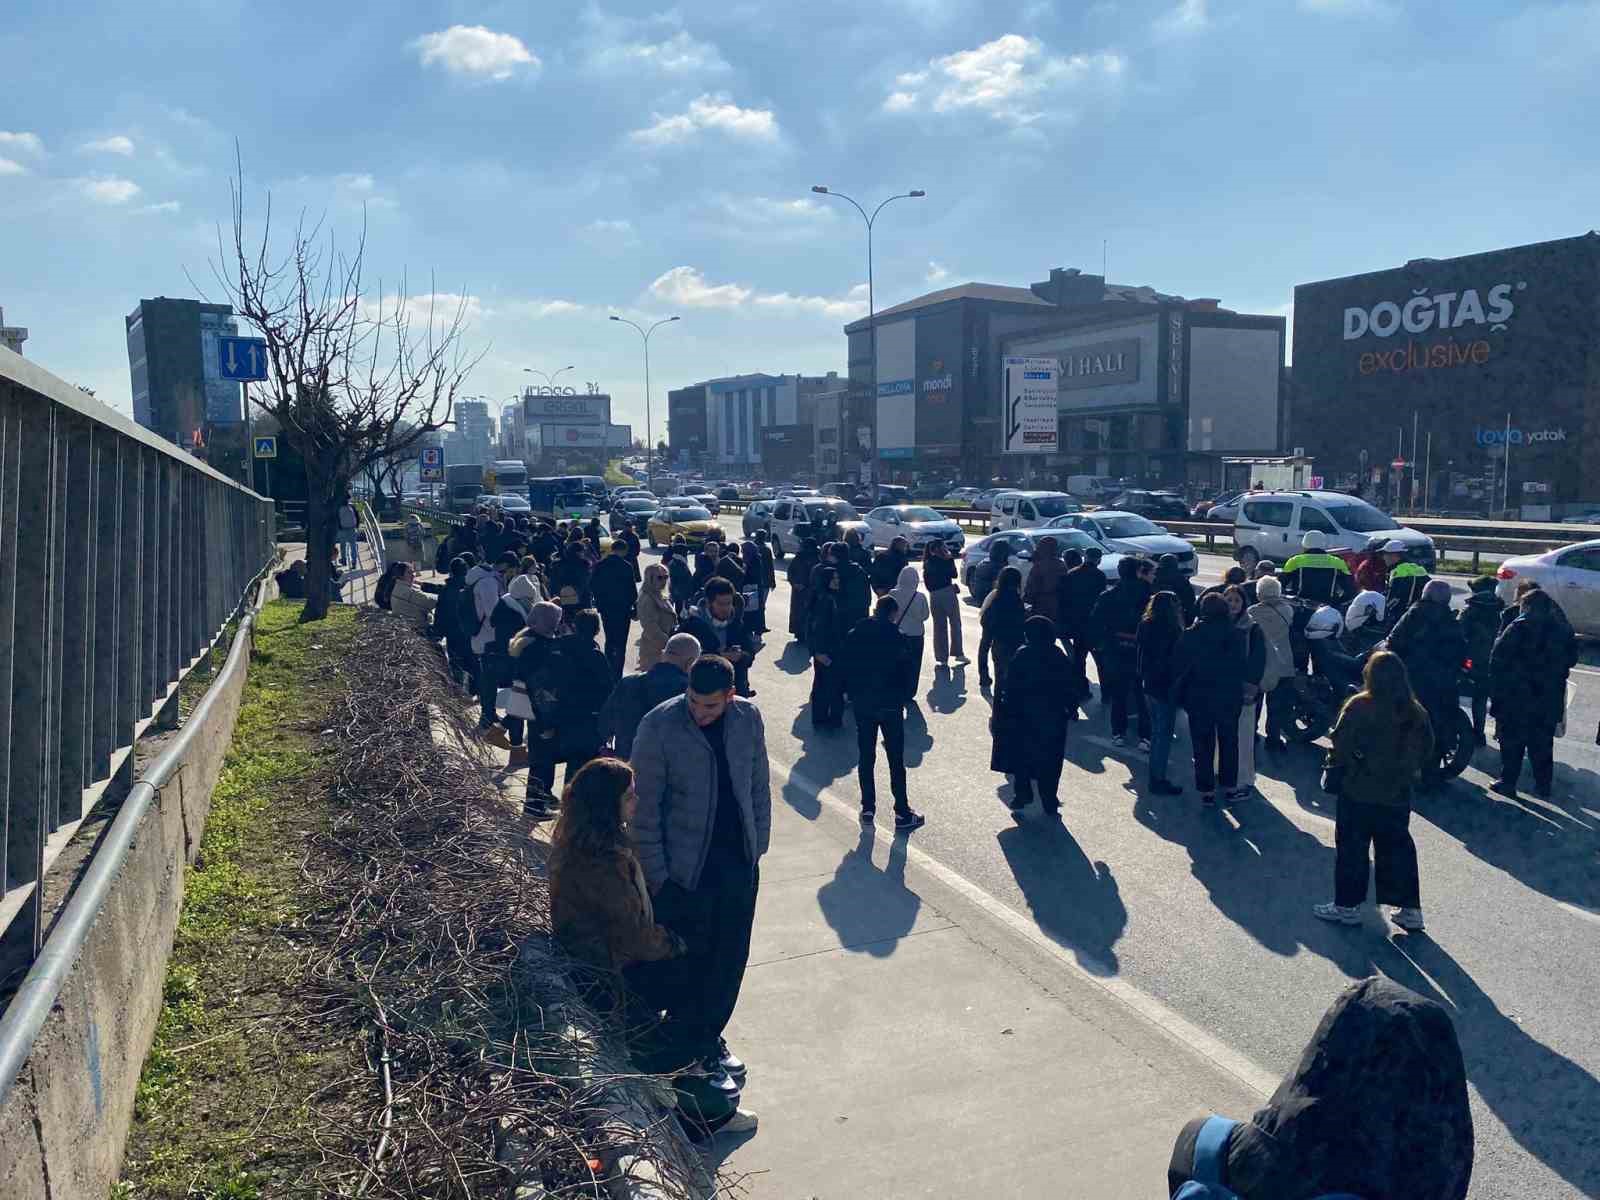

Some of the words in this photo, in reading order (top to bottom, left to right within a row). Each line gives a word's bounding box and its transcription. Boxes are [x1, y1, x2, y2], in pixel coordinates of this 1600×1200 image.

[1343, 284, 1514, 341] DOĞTAŞ
[1360, 336, 1490, 375] exclusive
[923, 374, 952, 392] mondi
[1526, 428, 1566, 445] yatak
